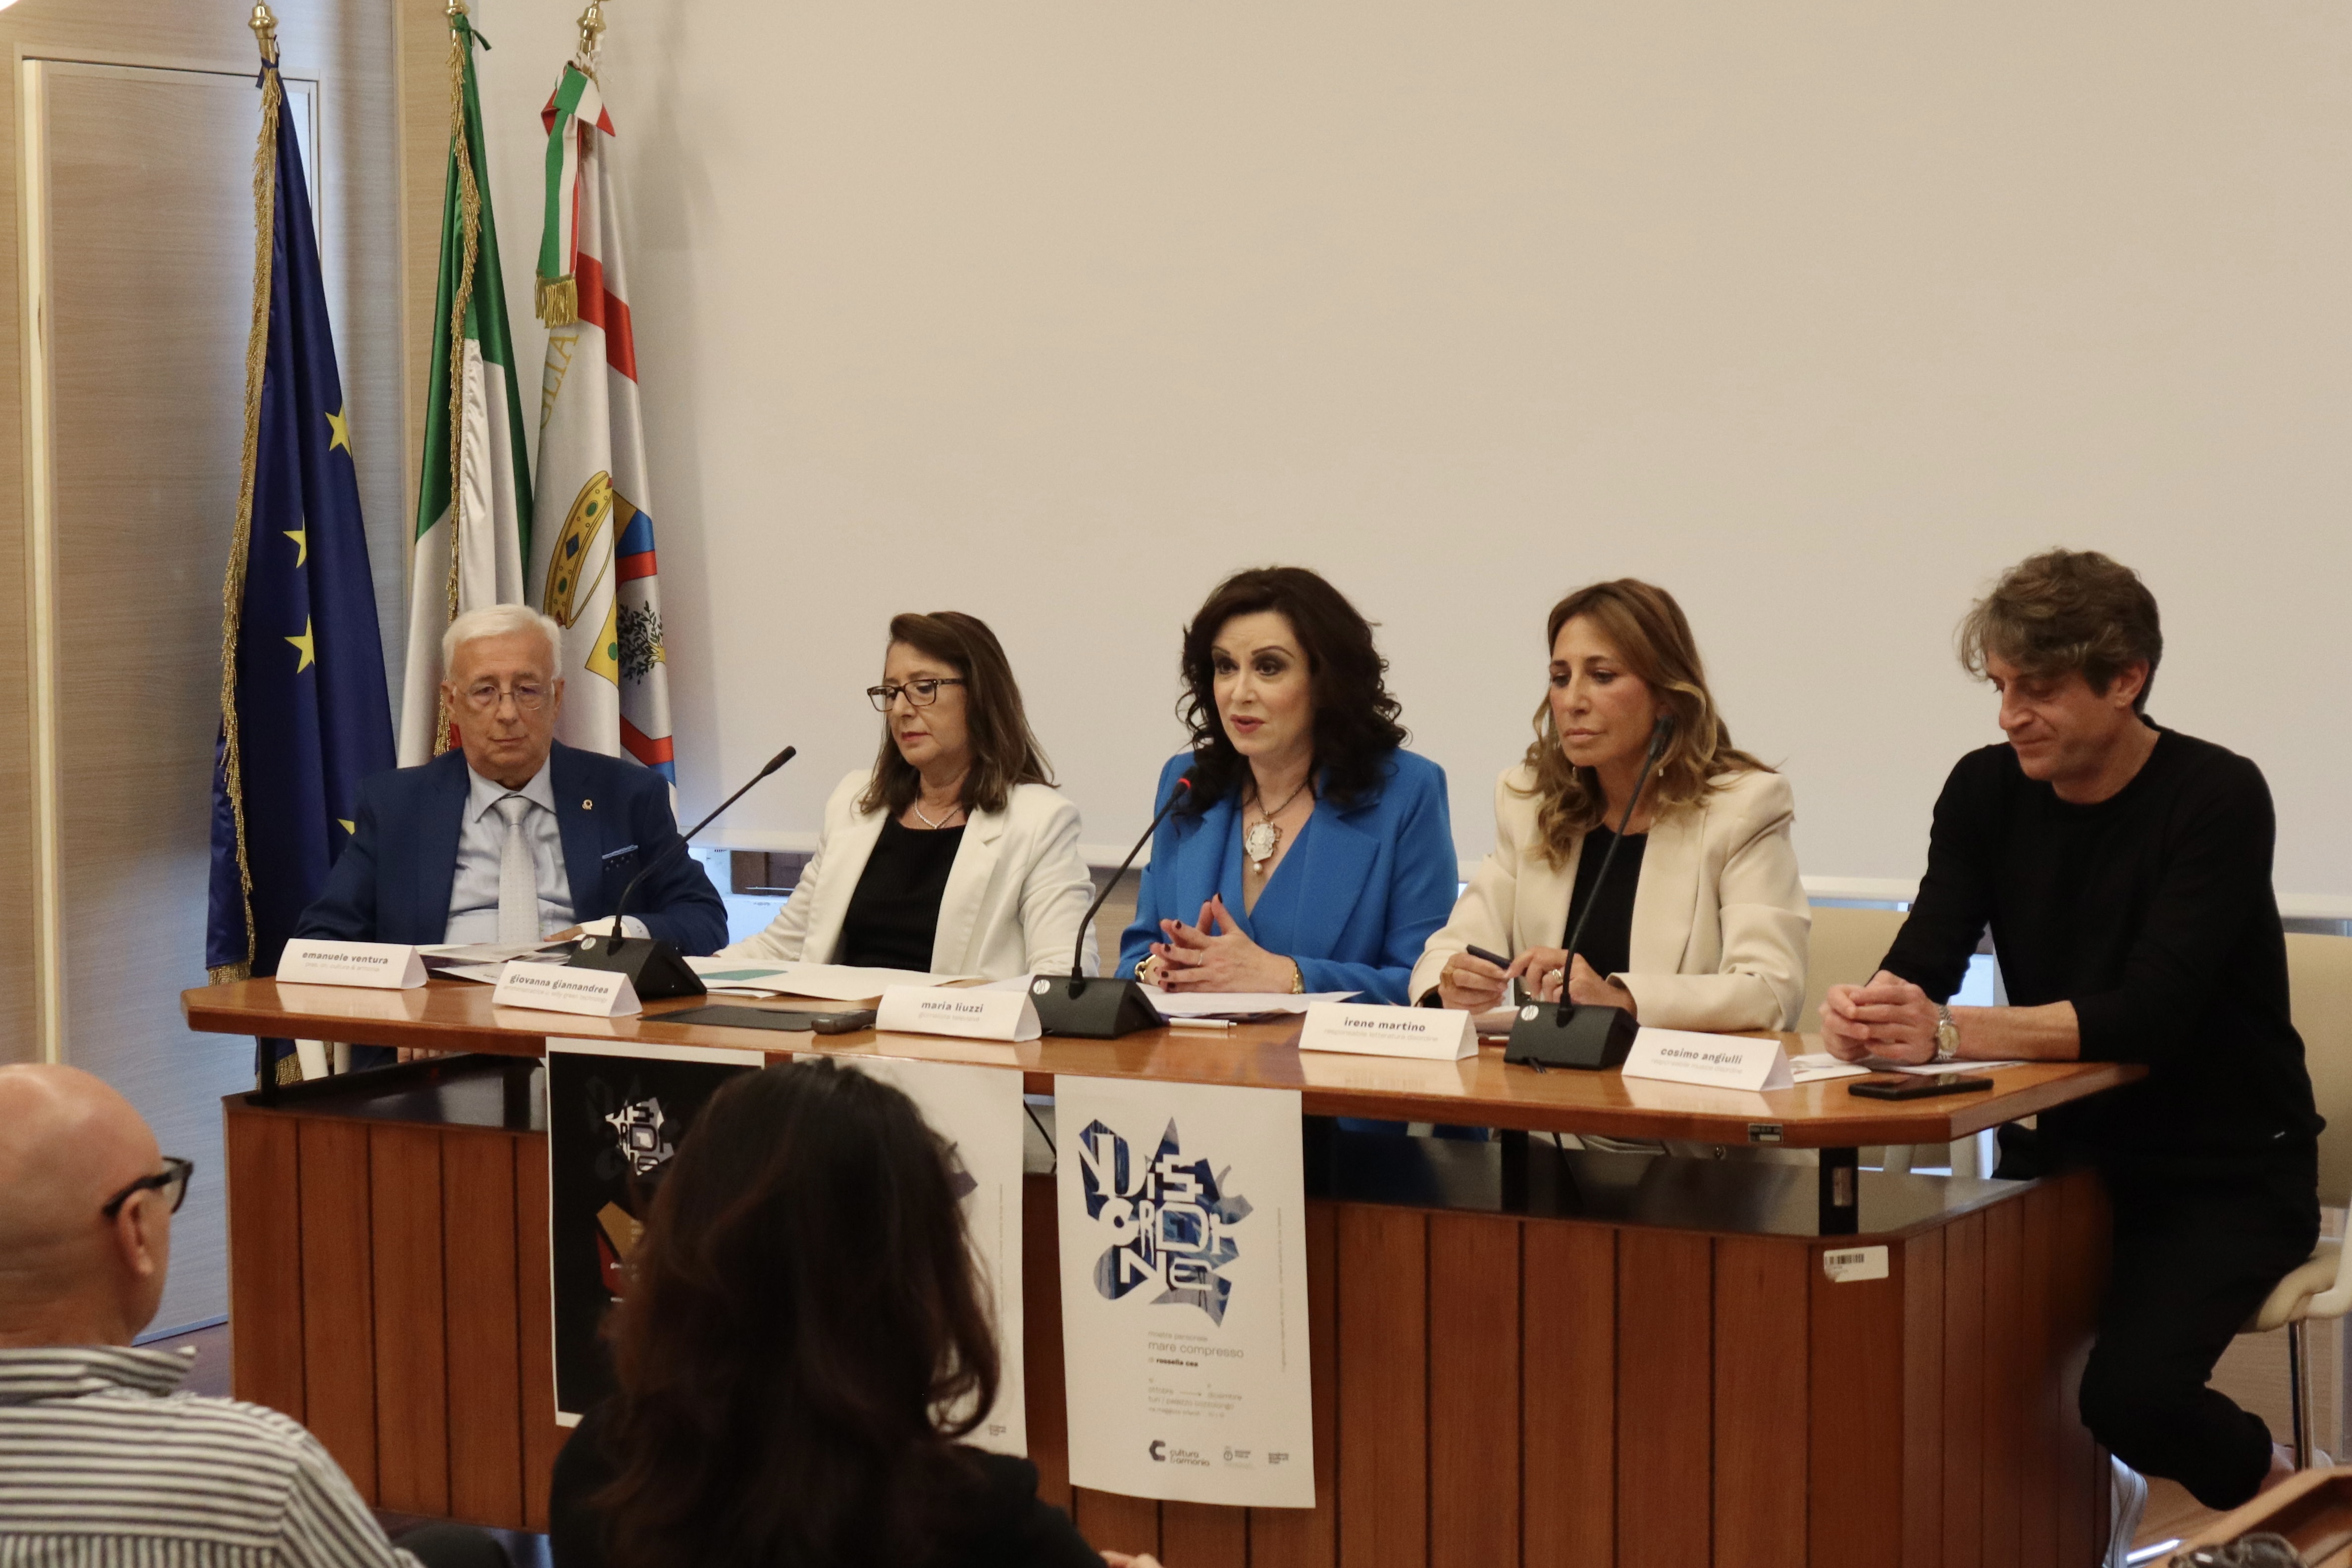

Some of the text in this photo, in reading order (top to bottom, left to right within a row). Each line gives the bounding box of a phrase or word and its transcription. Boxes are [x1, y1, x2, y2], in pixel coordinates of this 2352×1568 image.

[302, 952, 388, 964] emanuele ventura
[510, 974, 609, 993] giovanna giannandrea
[921, 1000, 984, 1013] maria liuzzi
[1344, 1017, 1426, 1032] irene martino
[1661, 1047, 1742, 1064] cosimo angiulli
[1148, 1342, 1244, 1359] mare compresso
[1170, 1449, 1199, 1459] cultura
